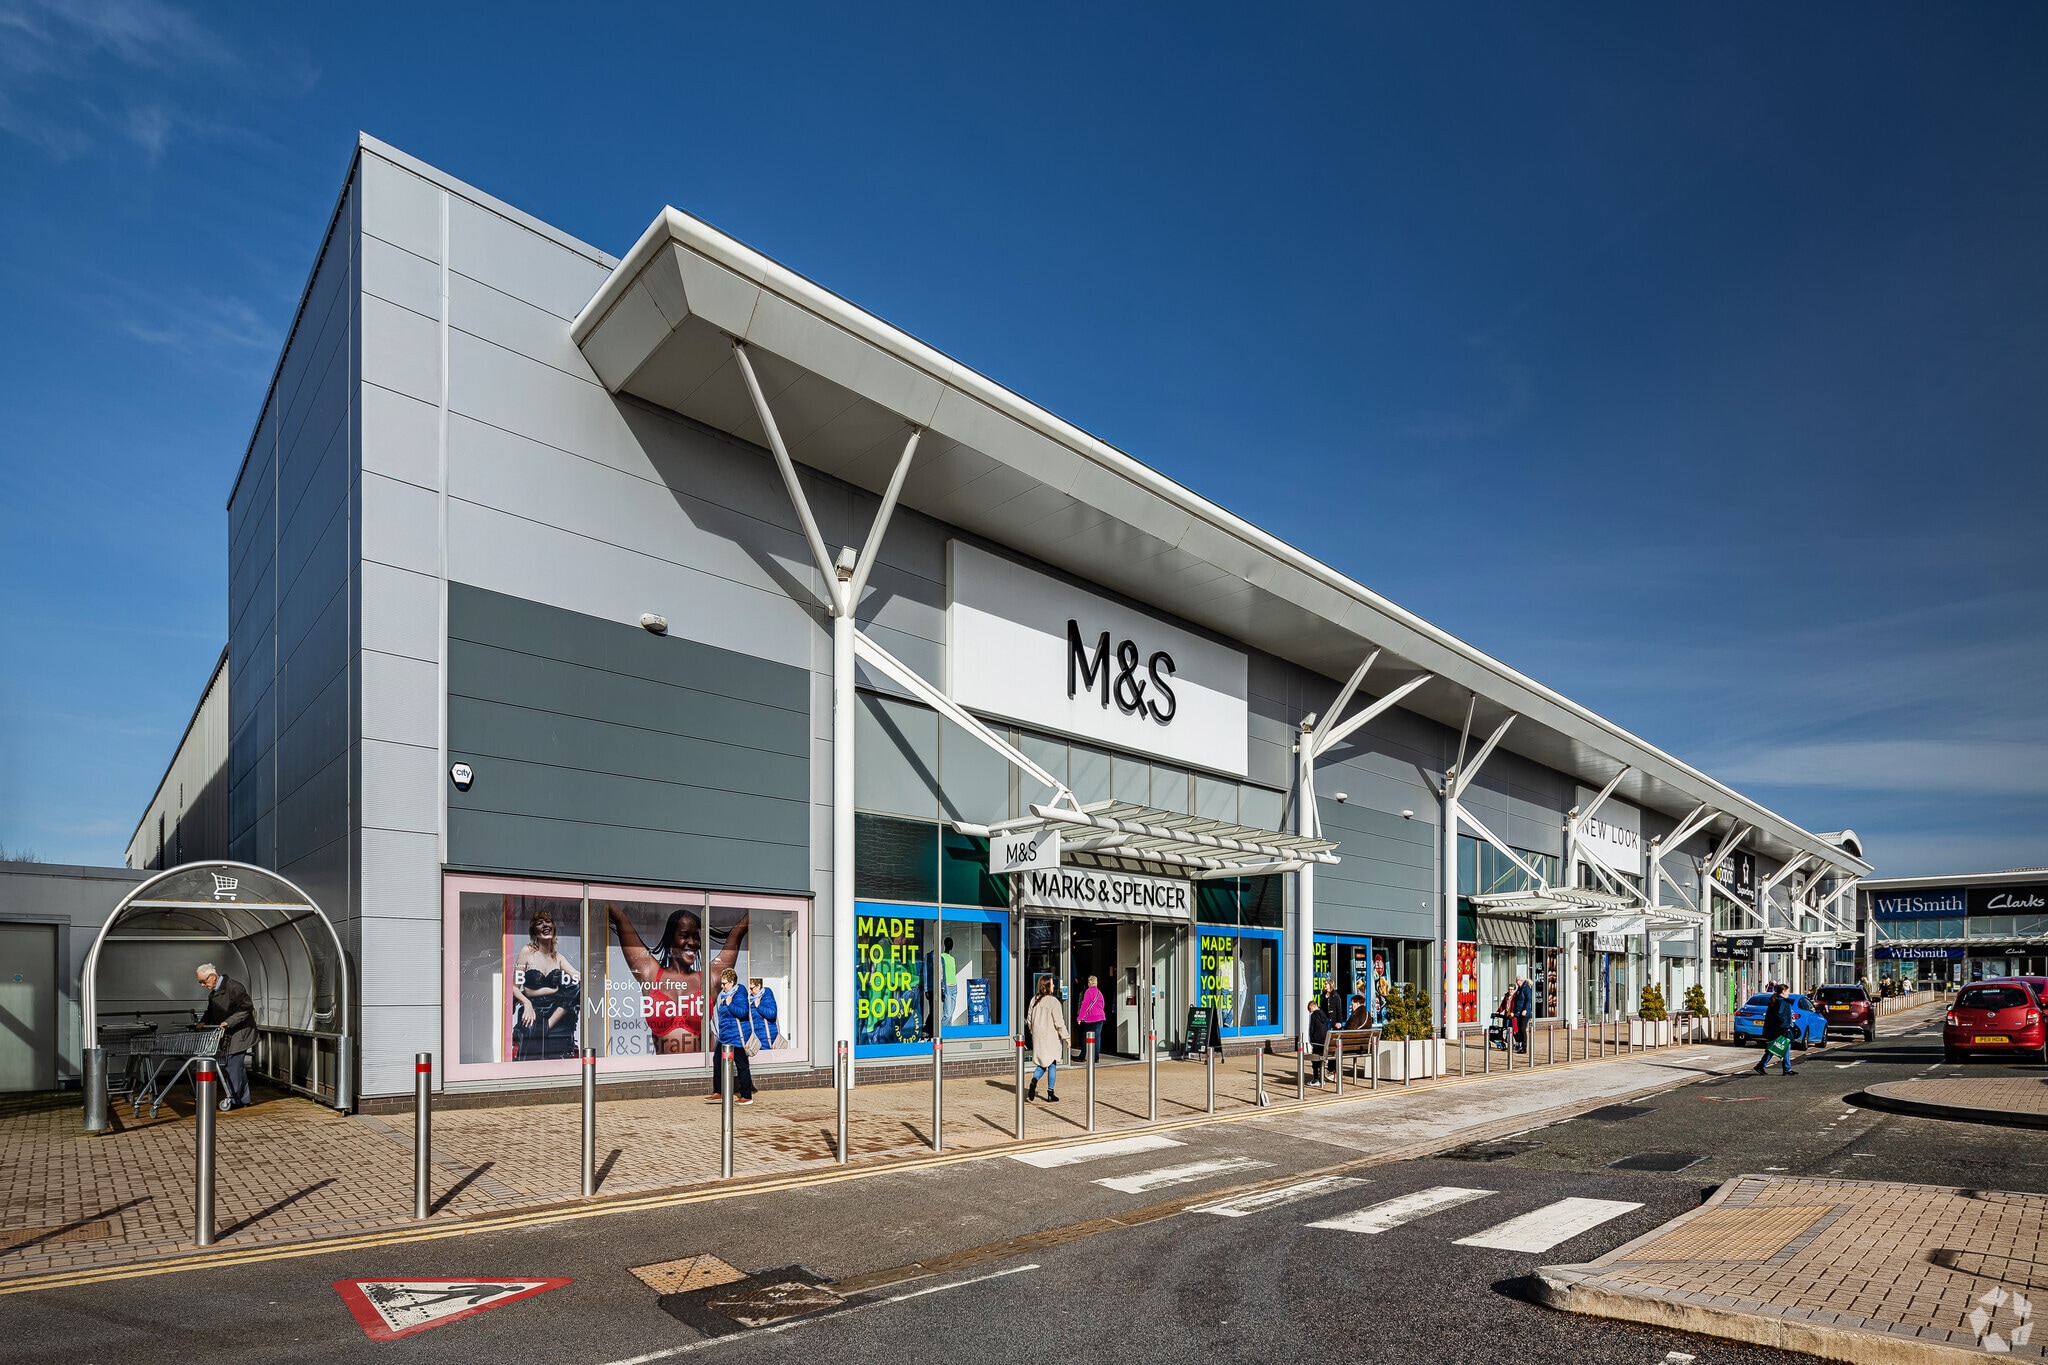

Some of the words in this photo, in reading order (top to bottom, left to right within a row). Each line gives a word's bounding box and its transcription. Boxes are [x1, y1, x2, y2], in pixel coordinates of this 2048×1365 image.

[1066, 618, 1177, 726] M&S
[1581, 816, 1607, 840] NEW
[1611, 824, 1638, 850] LOOK
[1006, 840, 1037, 864] M&S
[1032, 871, 1096, 901] MARKS
[1098, 879, 1110, 903] &
[1112, 881, 1186, 909] SPENCER
[1877, 895, 1963, 914] WHSmith
[1987, 893, 2046, 909] Clarks
[858, 916, 915, 939] MADE
[1574, 917, 1598, 929] M&S
[1201, 935, 1232, 951] MADE
[1312, 942, 1327, 956] ADE
[857, 943, 885, 964] TO
[890, 944, 919, 965] FIT
[1891, 947, 1948, 958] WHSmith
[1201, 955, 1216, 970] TO
[1218, 955, 1234, 970] FIT
[1315, 959, 1328, 973] FIT
[604, 979, 635, 991] Book
[638, 981, 663, 993] your
[665, 978, 688, 991] free
[857, 971, 913, 992] YOUR
[1201, 975, 1231, 990] YOUR
[587, 996, 635, 1019] M&S
[639, 993, 704, 1018] BraFit
[857, 998, 913, 1019] BODY
[1201, 994, 1233, 1009] STYLE
